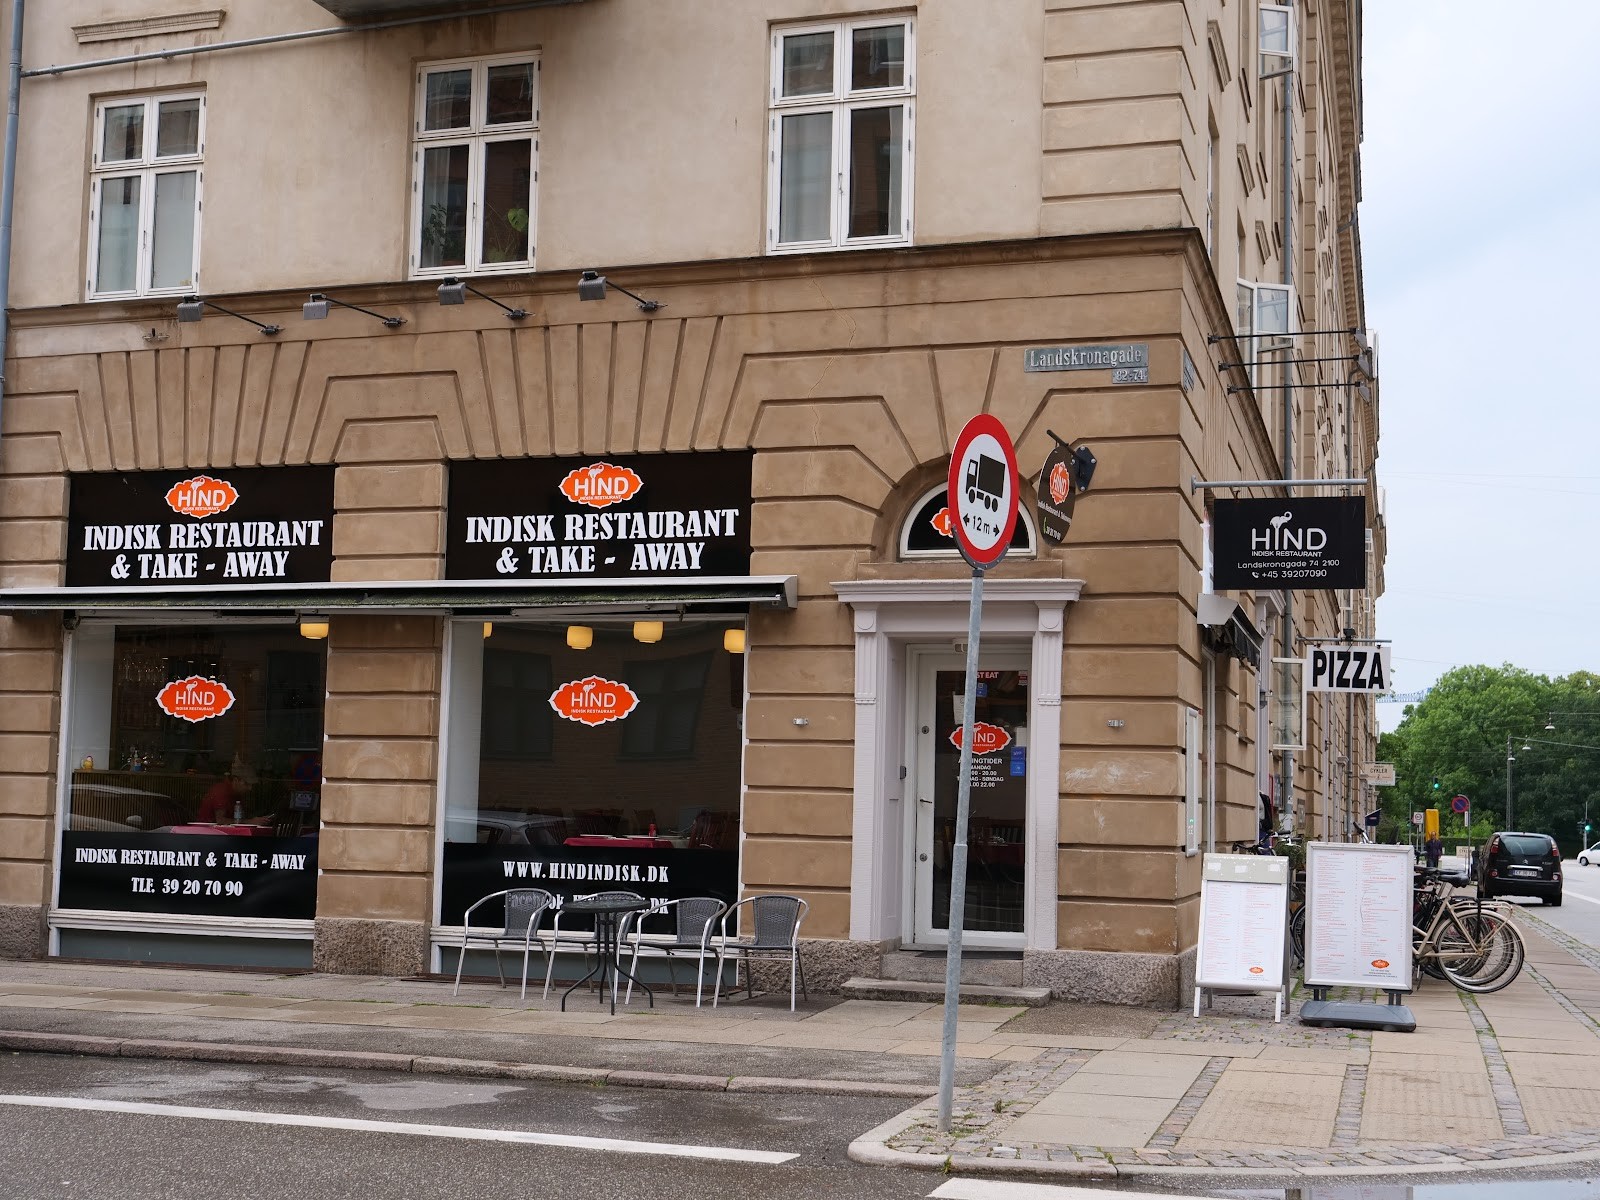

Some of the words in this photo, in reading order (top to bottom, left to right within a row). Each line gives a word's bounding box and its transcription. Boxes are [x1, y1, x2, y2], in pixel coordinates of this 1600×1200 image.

[1030, 346, 1141, 367] Landskronagade
[574, 477, 629, 496] HIND
[178, 489, 226, 507] HIND
[83, 525, 161, 550] INDISK
[169, 520, 323, 550] RESTAURANT
[465, 515, 555, 543] INDISK
[564, 509, 739, 541] RESTAURANT
[972, 515, 983, 532] 12
[983, 522, 991, 535] m
[1251, 527, 1327, 550] HIND
[111, 554, 131, 579] &
[138, 553, 198, 579] TAKE
[223, 551, 289, 578] AWAY
[495, 547, 519, 573] &
[528, 545, 595, 573] TAKE
[630, 542, 705, 571] AWAY
[1237, 560, 1306, 569] Landskronagade
[1261, 570, 1278, 578] +45
[1281, 569, 1327, 578] 39207090
[985, 671, 999, 679] EAT
[1312, 651, 1385, 690] PIZZA
[175, 691, 216, 706] HIND
[571, 692, 617, 707] HIND
[75, 848, 117, 864] INDISK
[120, 849, 201, 867] RESTAURANT
[205, 851, 217, 867] &
[224, 852, 258, 869] TAKE
[270, 854, 306, 870] AWAY
[131, 877, 155, 893] TLF.
[162, 878, 180, 894] 39
[182, 879, 200, 895] 20
[204, 880, 222, 896] 70
[225, 880, 243, 897] 90
